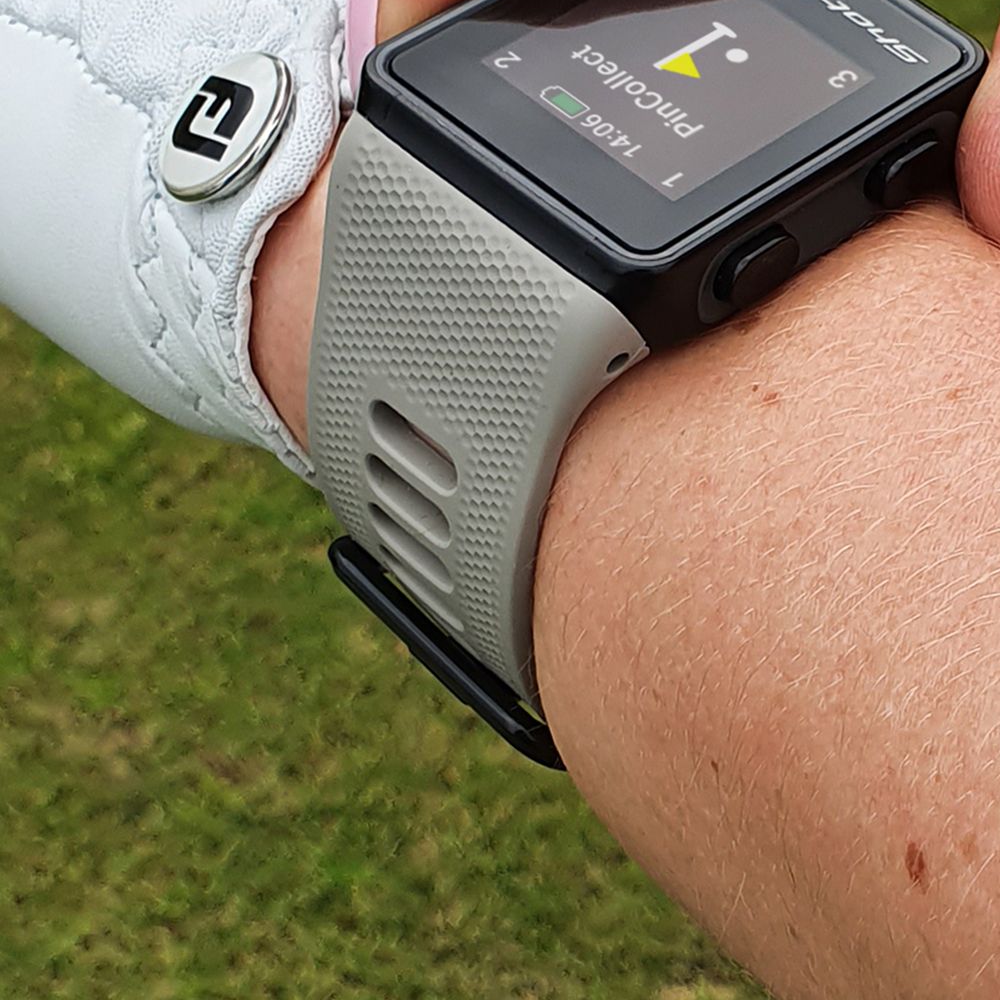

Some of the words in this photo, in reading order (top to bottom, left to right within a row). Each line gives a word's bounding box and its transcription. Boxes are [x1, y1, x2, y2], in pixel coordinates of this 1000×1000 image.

[493, 50, 522, 69] 2
[827, 69, 859, 89] 3
[570, 43, 705, 139] PinCollect
[579, 113, 643, 158] 14:06
[660, 171, 684, 188] 1
